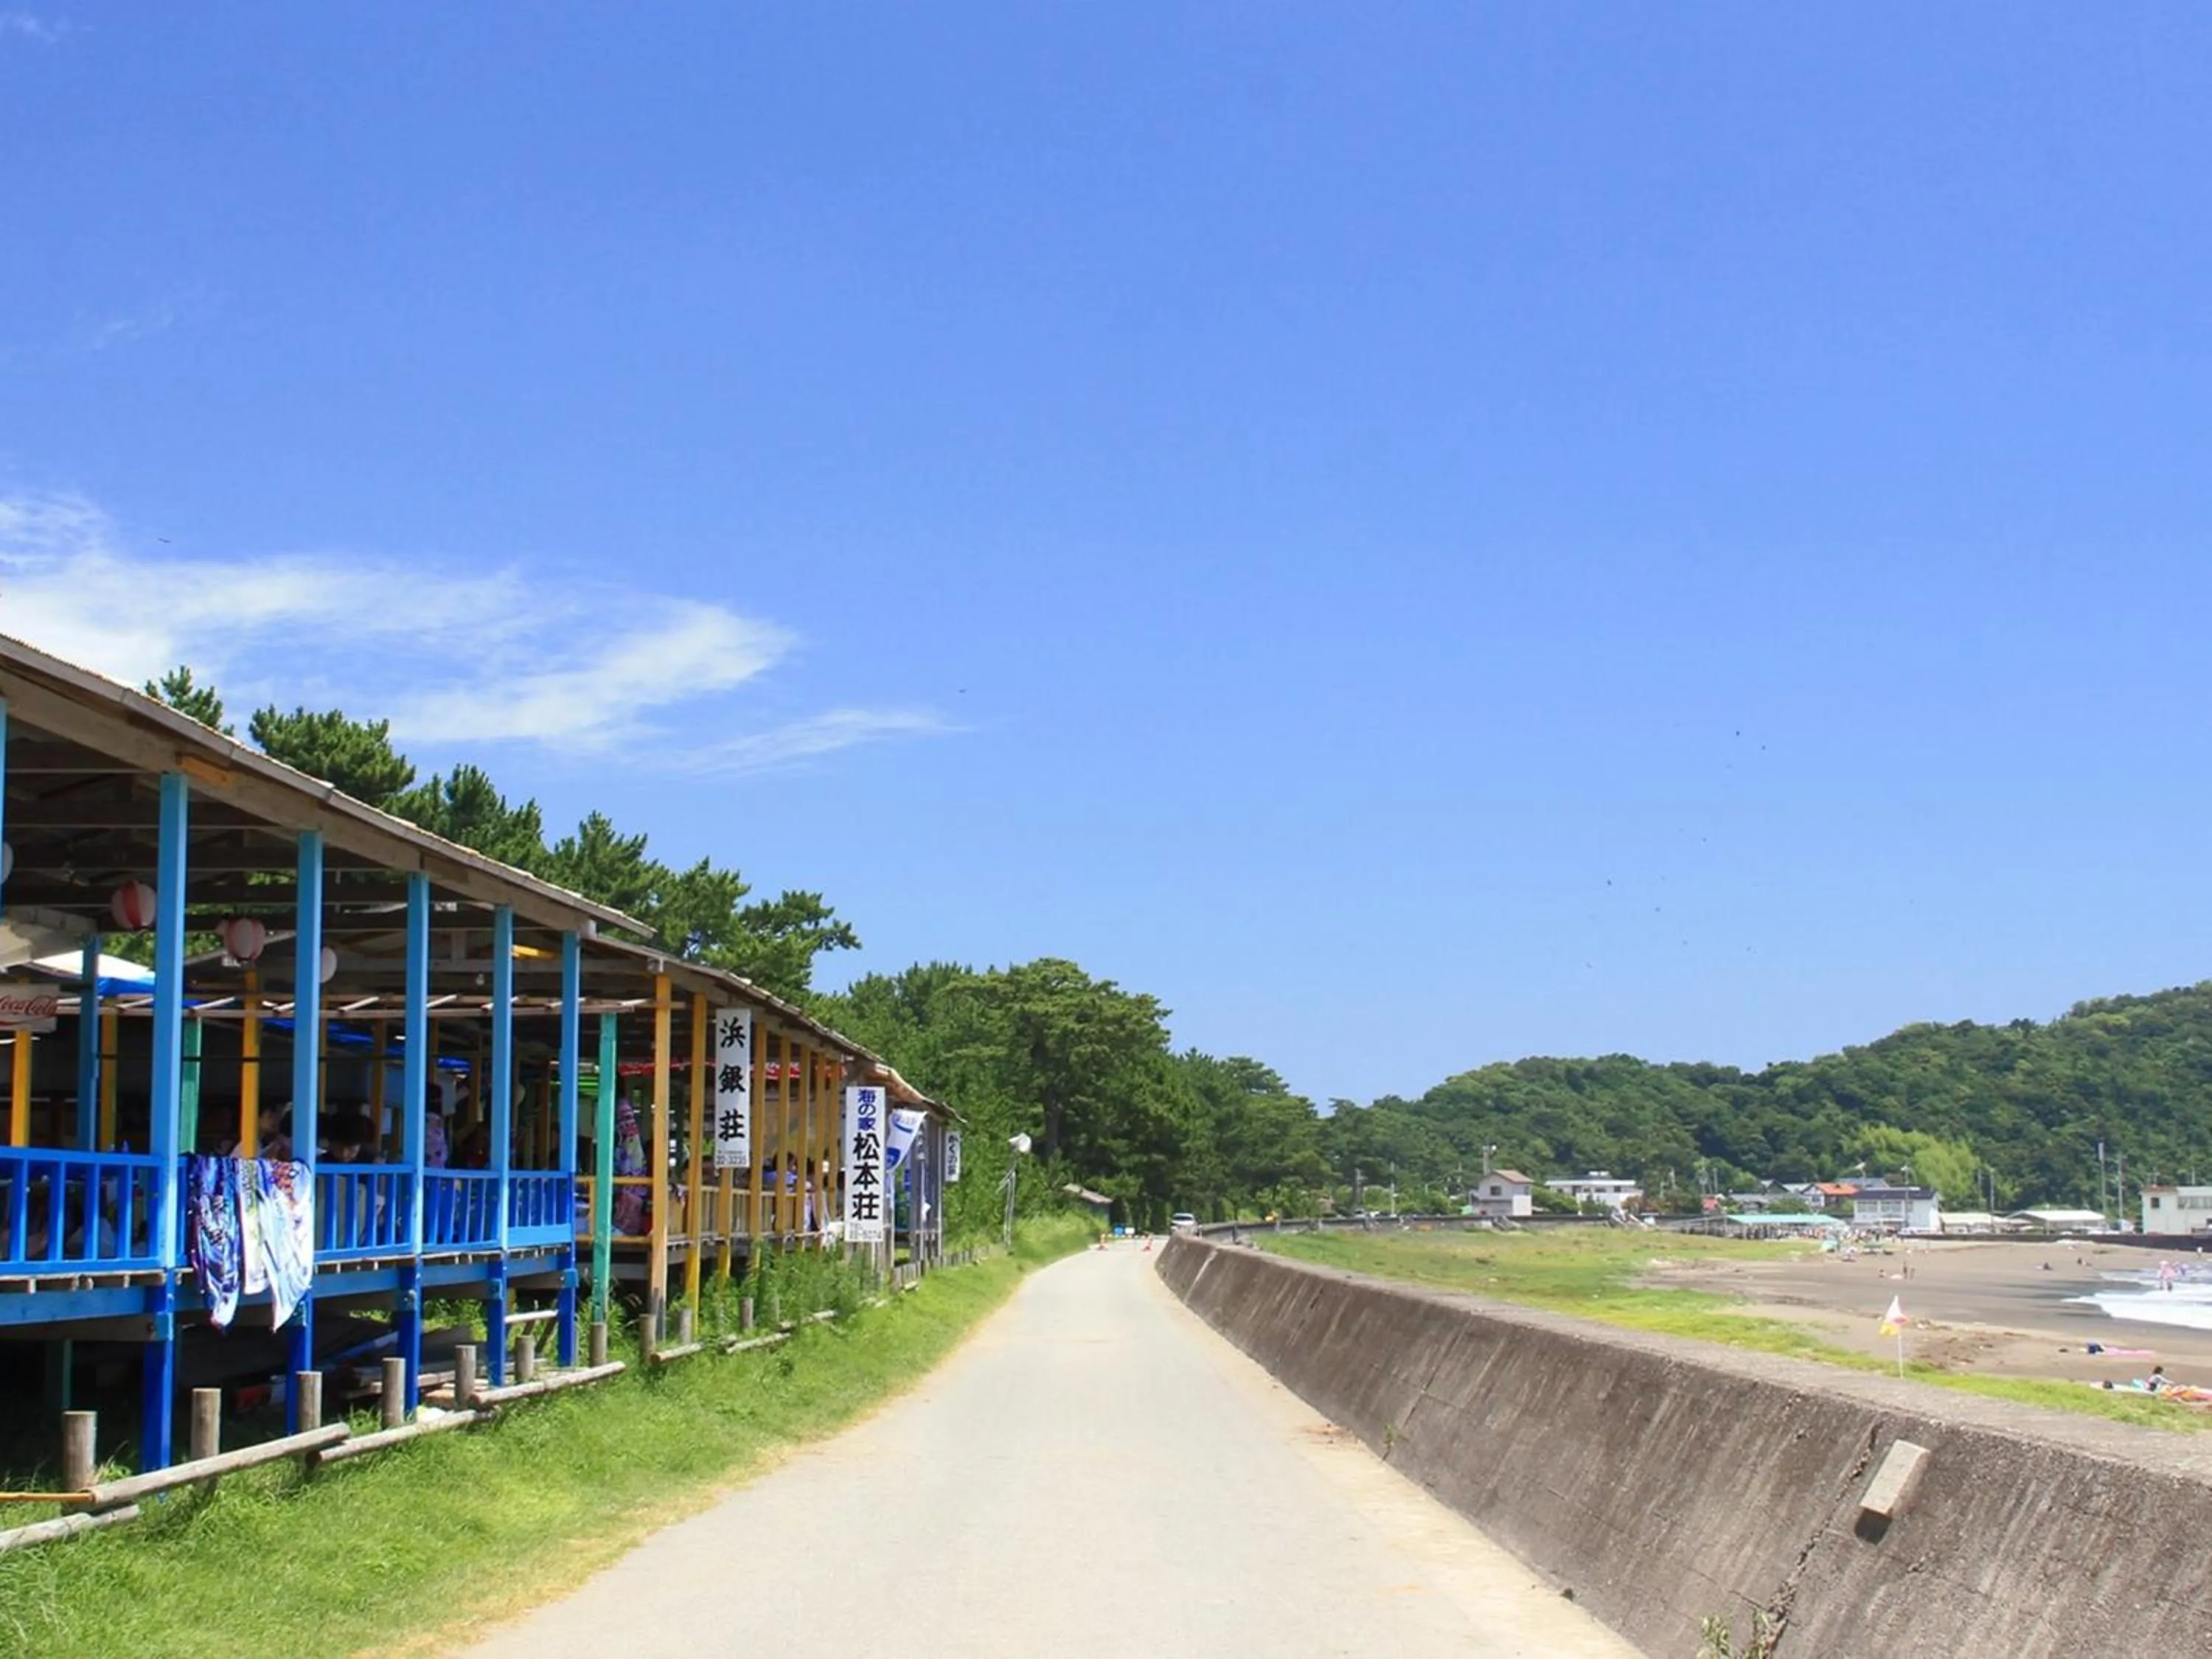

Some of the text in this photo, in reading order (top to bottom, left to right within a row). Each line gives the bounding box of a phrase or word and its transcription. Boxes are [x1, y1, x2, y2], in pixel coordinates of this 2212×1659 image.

[719, 1017, 745, 1141] 浜銀荘
[858, 1089, 876, 1130] 海の家
[852, 1132, 880, 1221] 松本荘
